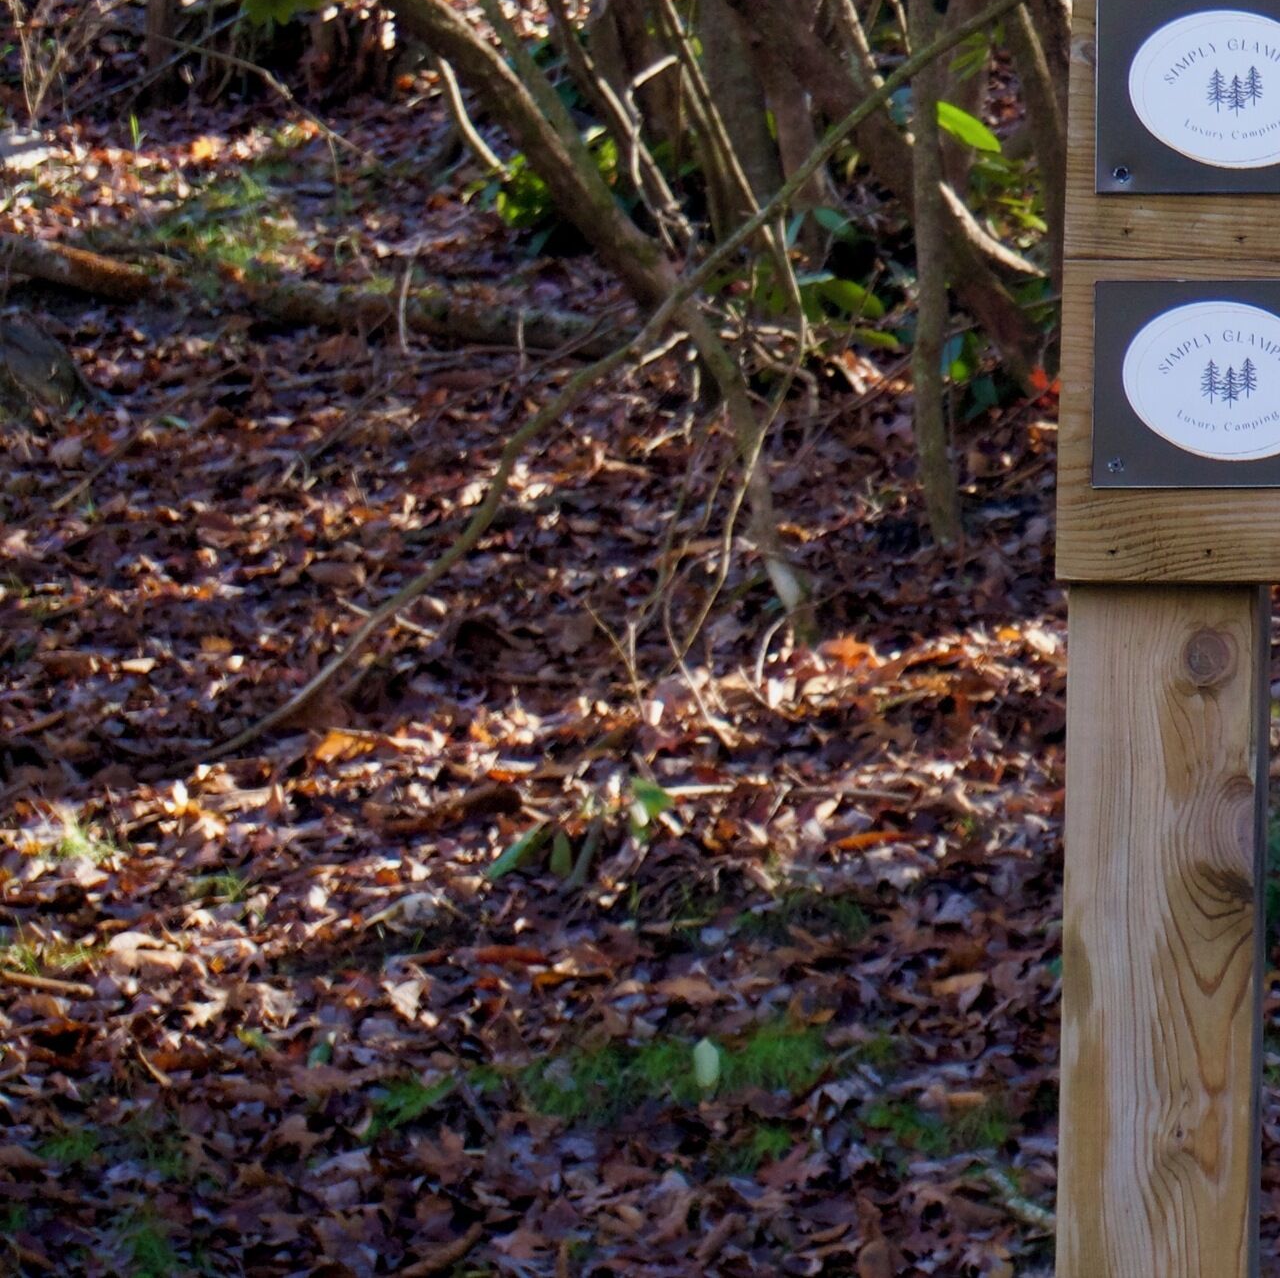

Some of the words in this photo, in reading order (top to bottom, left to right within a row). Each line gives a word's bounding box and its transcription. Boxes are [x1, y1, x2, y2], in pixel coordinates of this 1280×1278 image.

[1163, 42, 1217, 85] SIMPLY
[1184, 118, 1224, 140] Luxury
[1158, 333, 1212, 375] SIMPLY
[1177, 409, 1217, 431] Luxury
[1224, 411, 1280, 432] Camping
